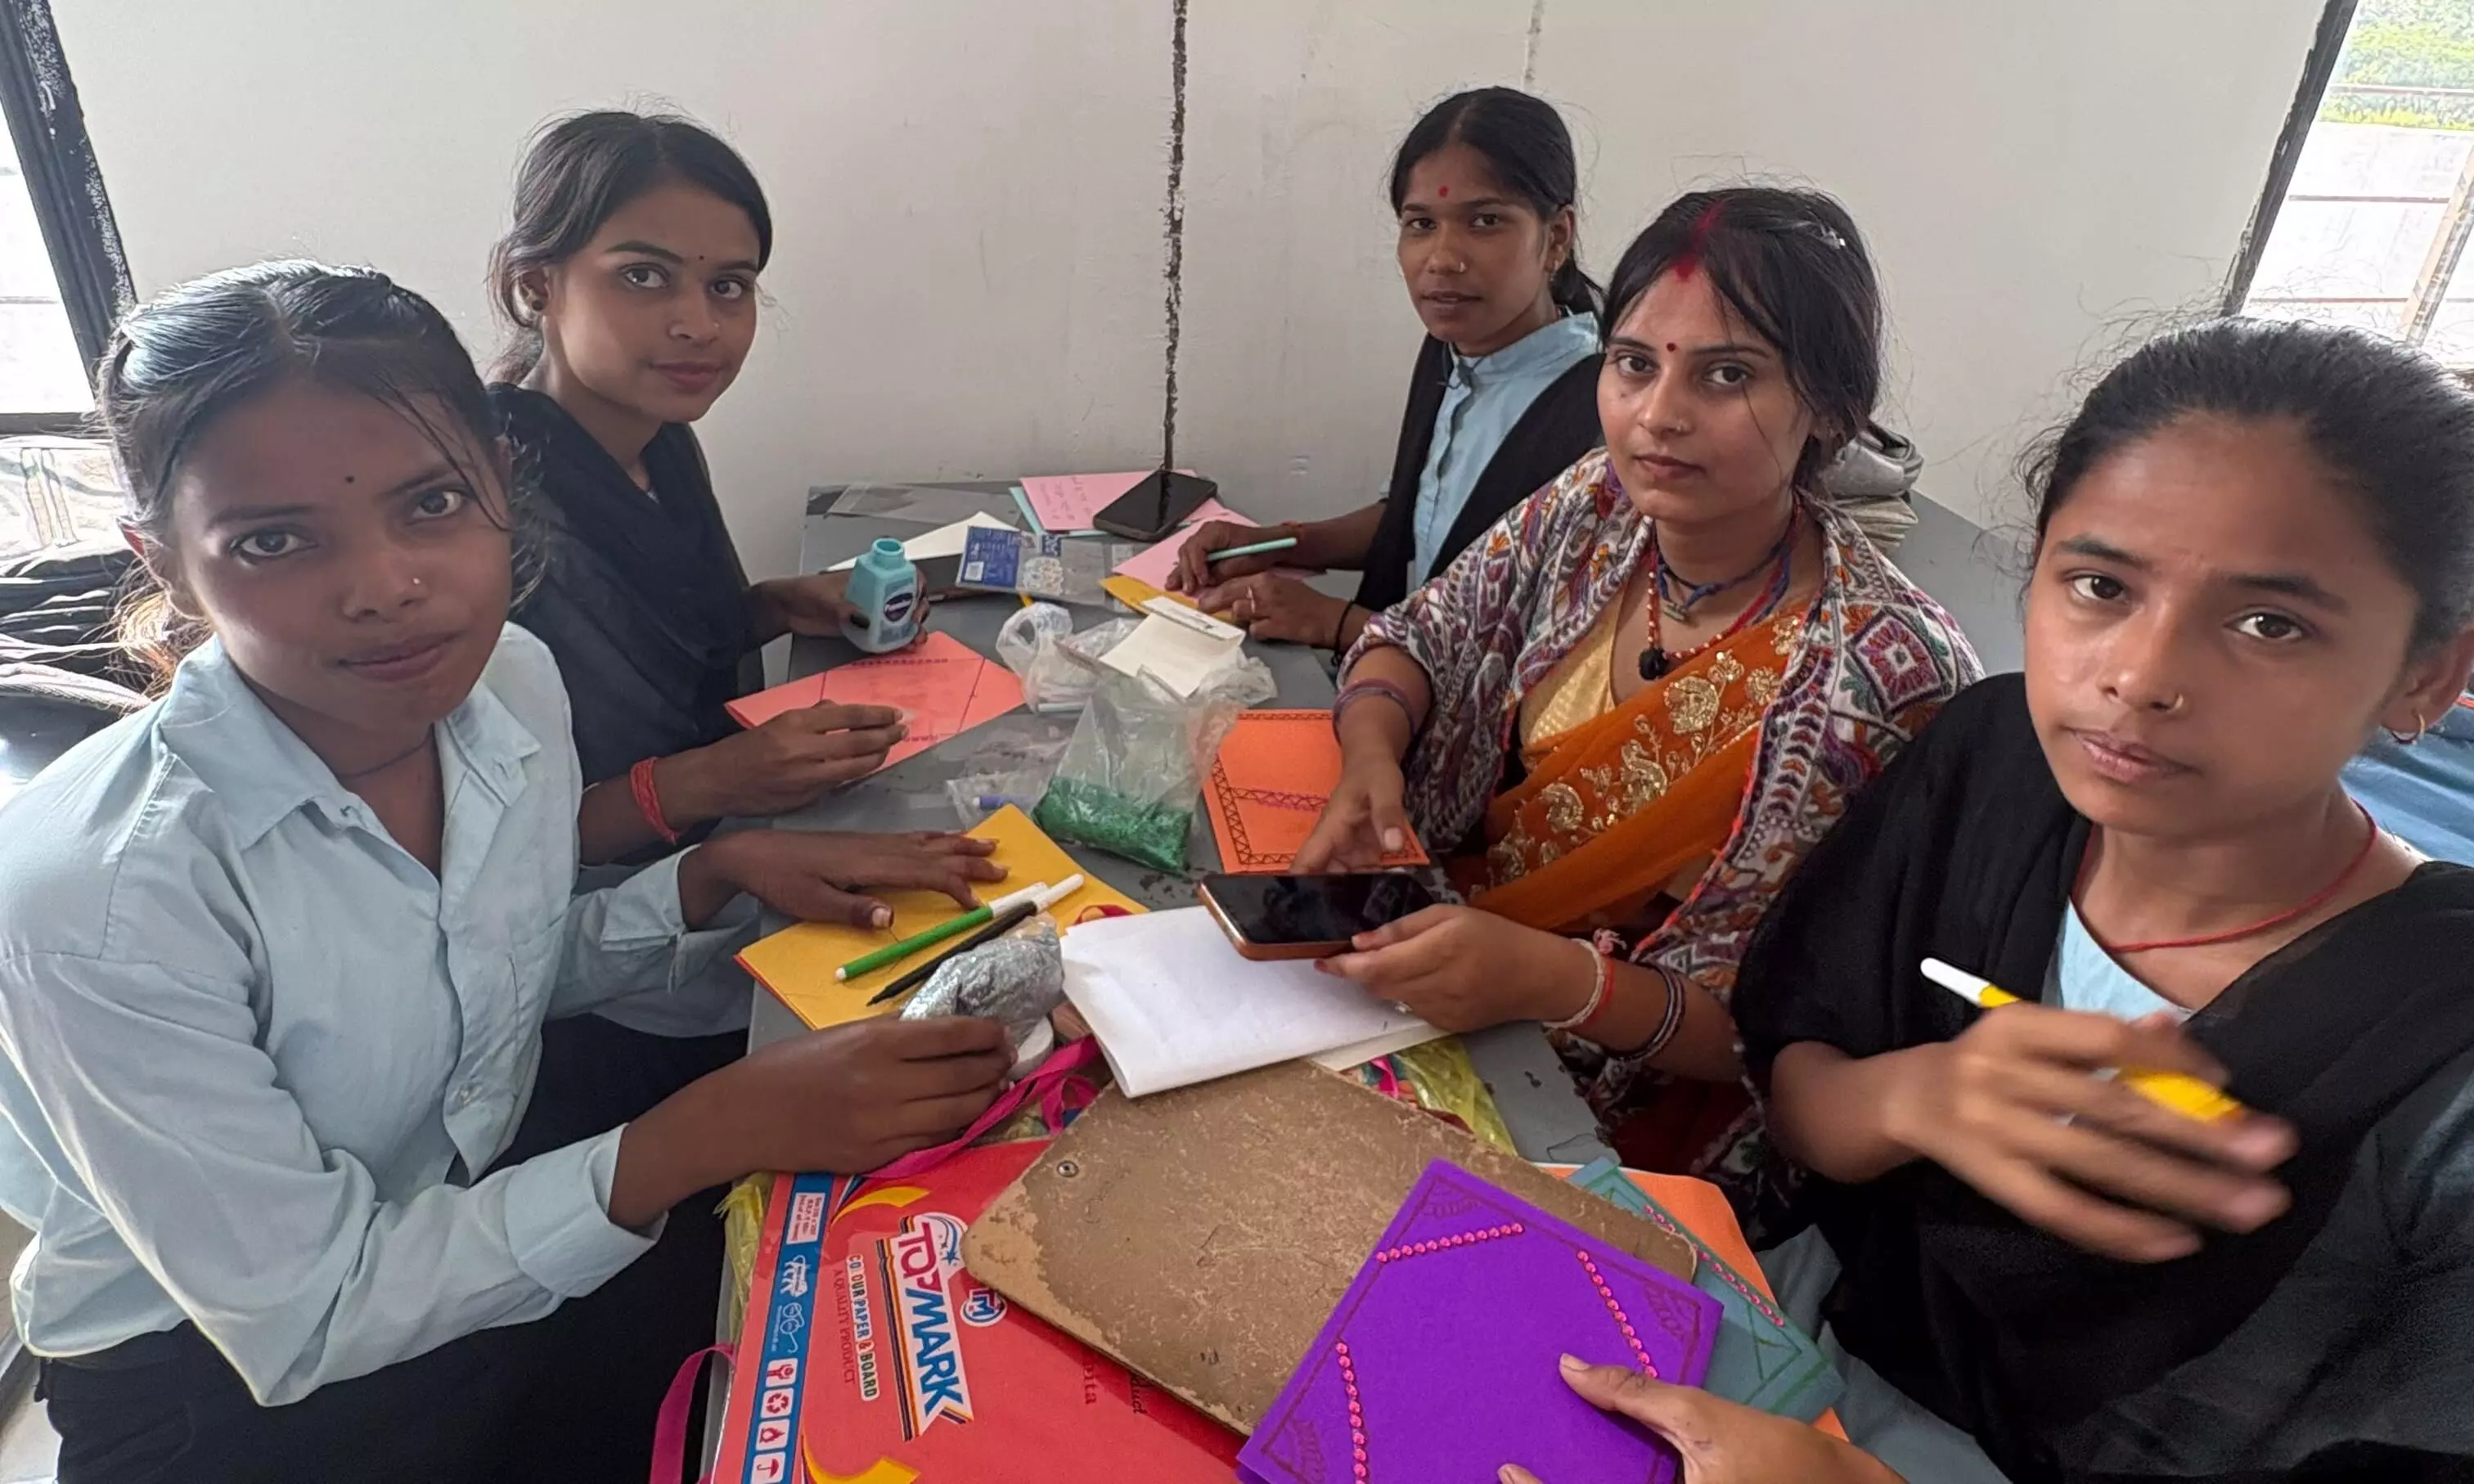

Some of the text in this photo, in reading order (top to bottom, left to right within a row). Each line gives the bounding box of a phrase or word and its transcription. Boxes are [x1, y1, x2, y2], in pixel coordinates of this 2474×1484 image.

[833, 1269, 855, 1385] A QUALITY PRODUCT
[848, 1254, 878, 1397] COLOUR PAPER & BOARD
[1132, 1377, 1155, 1414] duct
